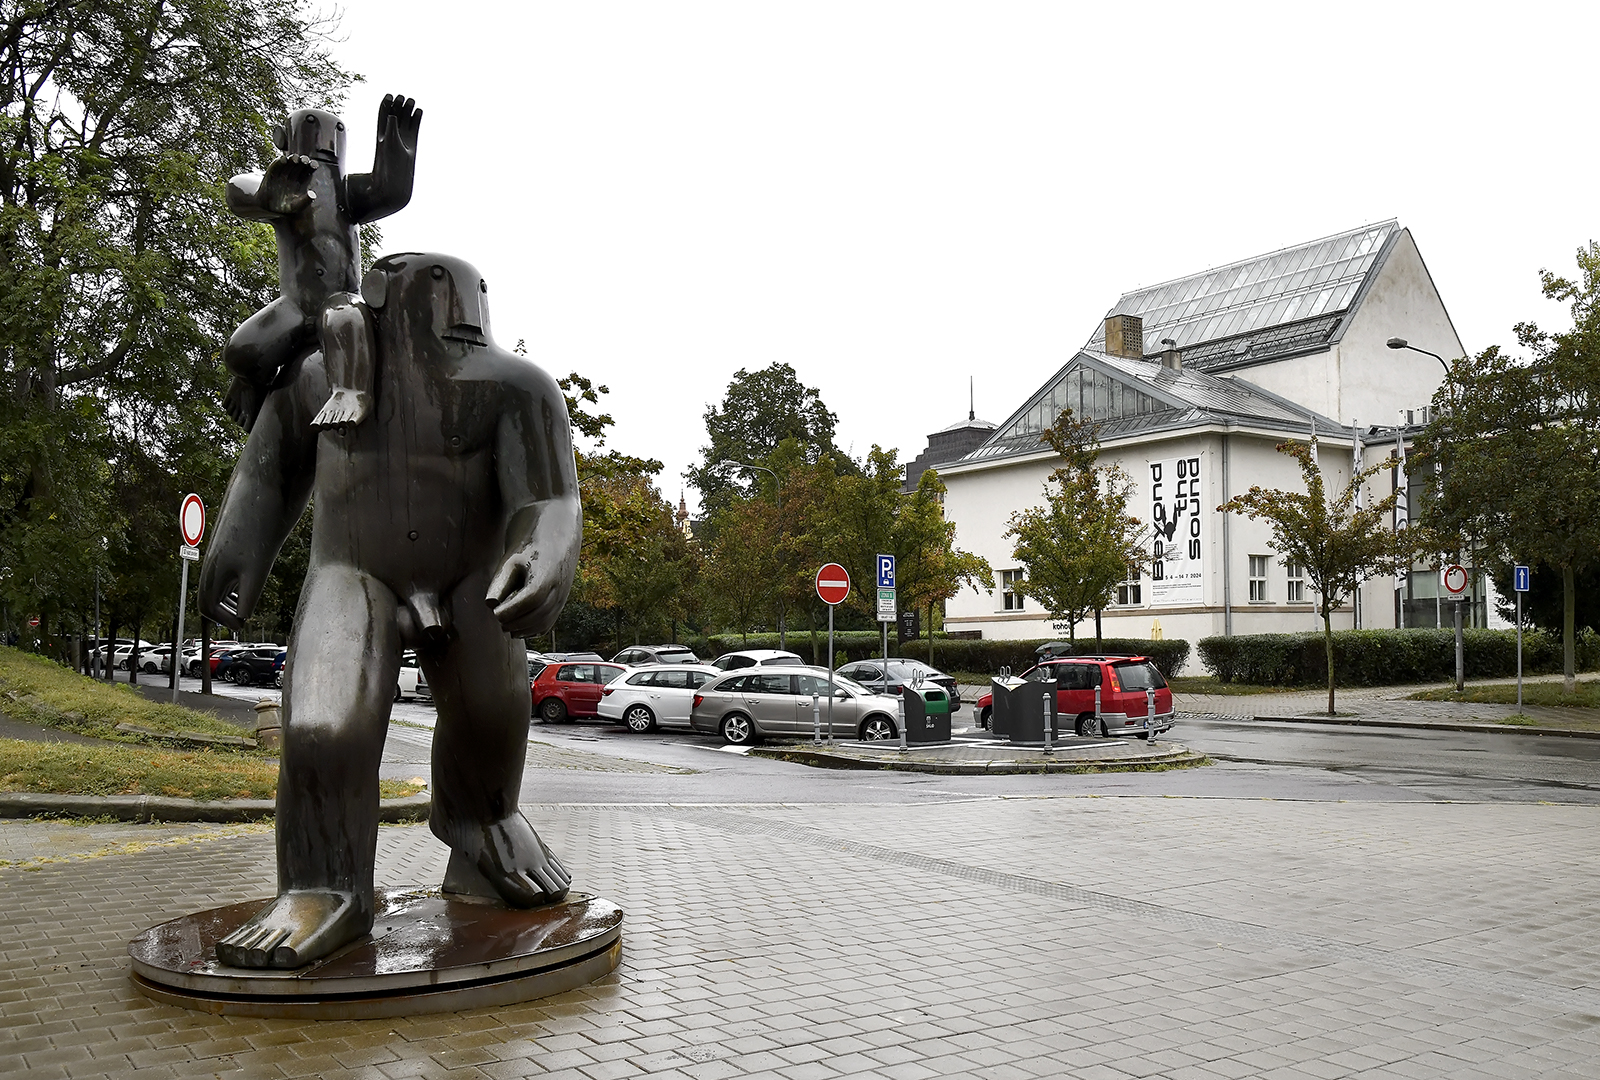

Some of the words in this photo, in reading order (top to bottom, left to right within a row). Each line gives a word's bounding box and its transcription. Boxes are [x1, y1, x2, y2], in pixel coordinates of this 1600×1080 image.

[1150, 463, 1165, 580] Beyond
[1175, 459, 1187, 517] the
[881, 559, 891, 577] P
